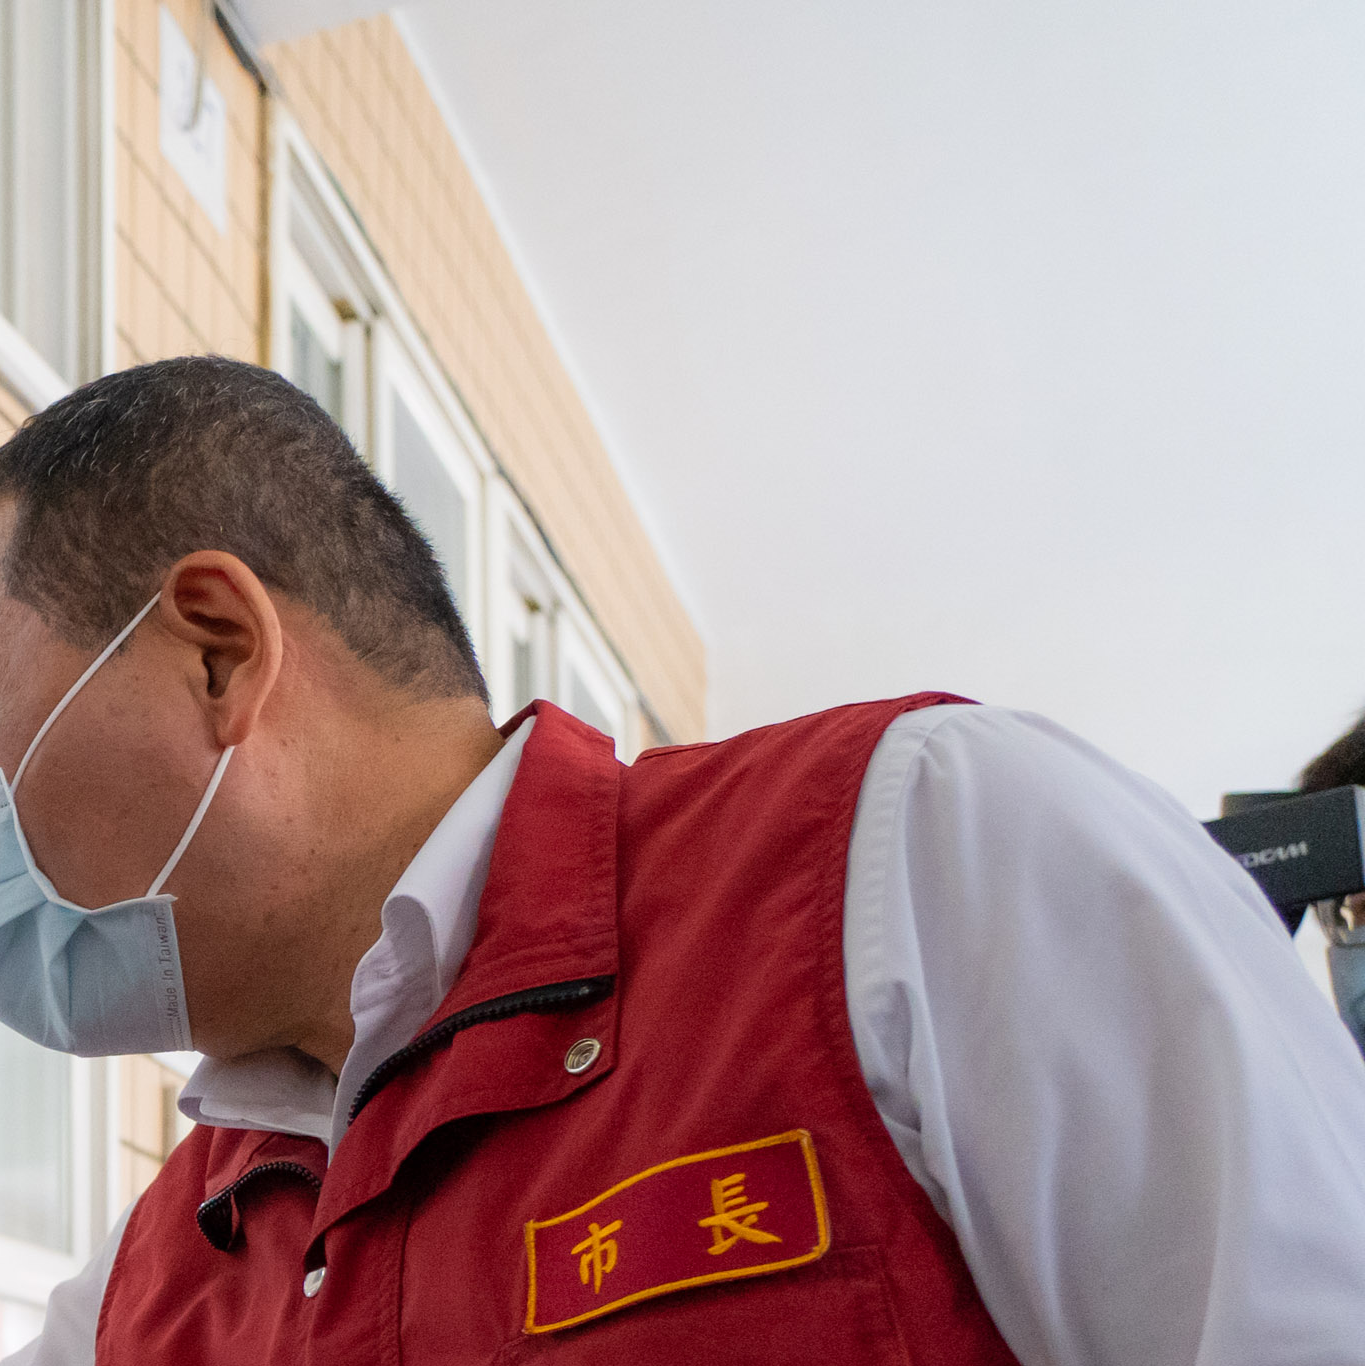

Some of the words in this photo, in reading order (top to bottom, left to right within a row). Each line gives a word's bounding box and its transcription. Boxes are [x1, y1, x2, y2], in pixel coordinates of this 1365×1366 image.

[156, 916, 172, 965] Taiwan
[166, 987, 179, 1018] Made
[570, 1173, 783, 1294] 市長
